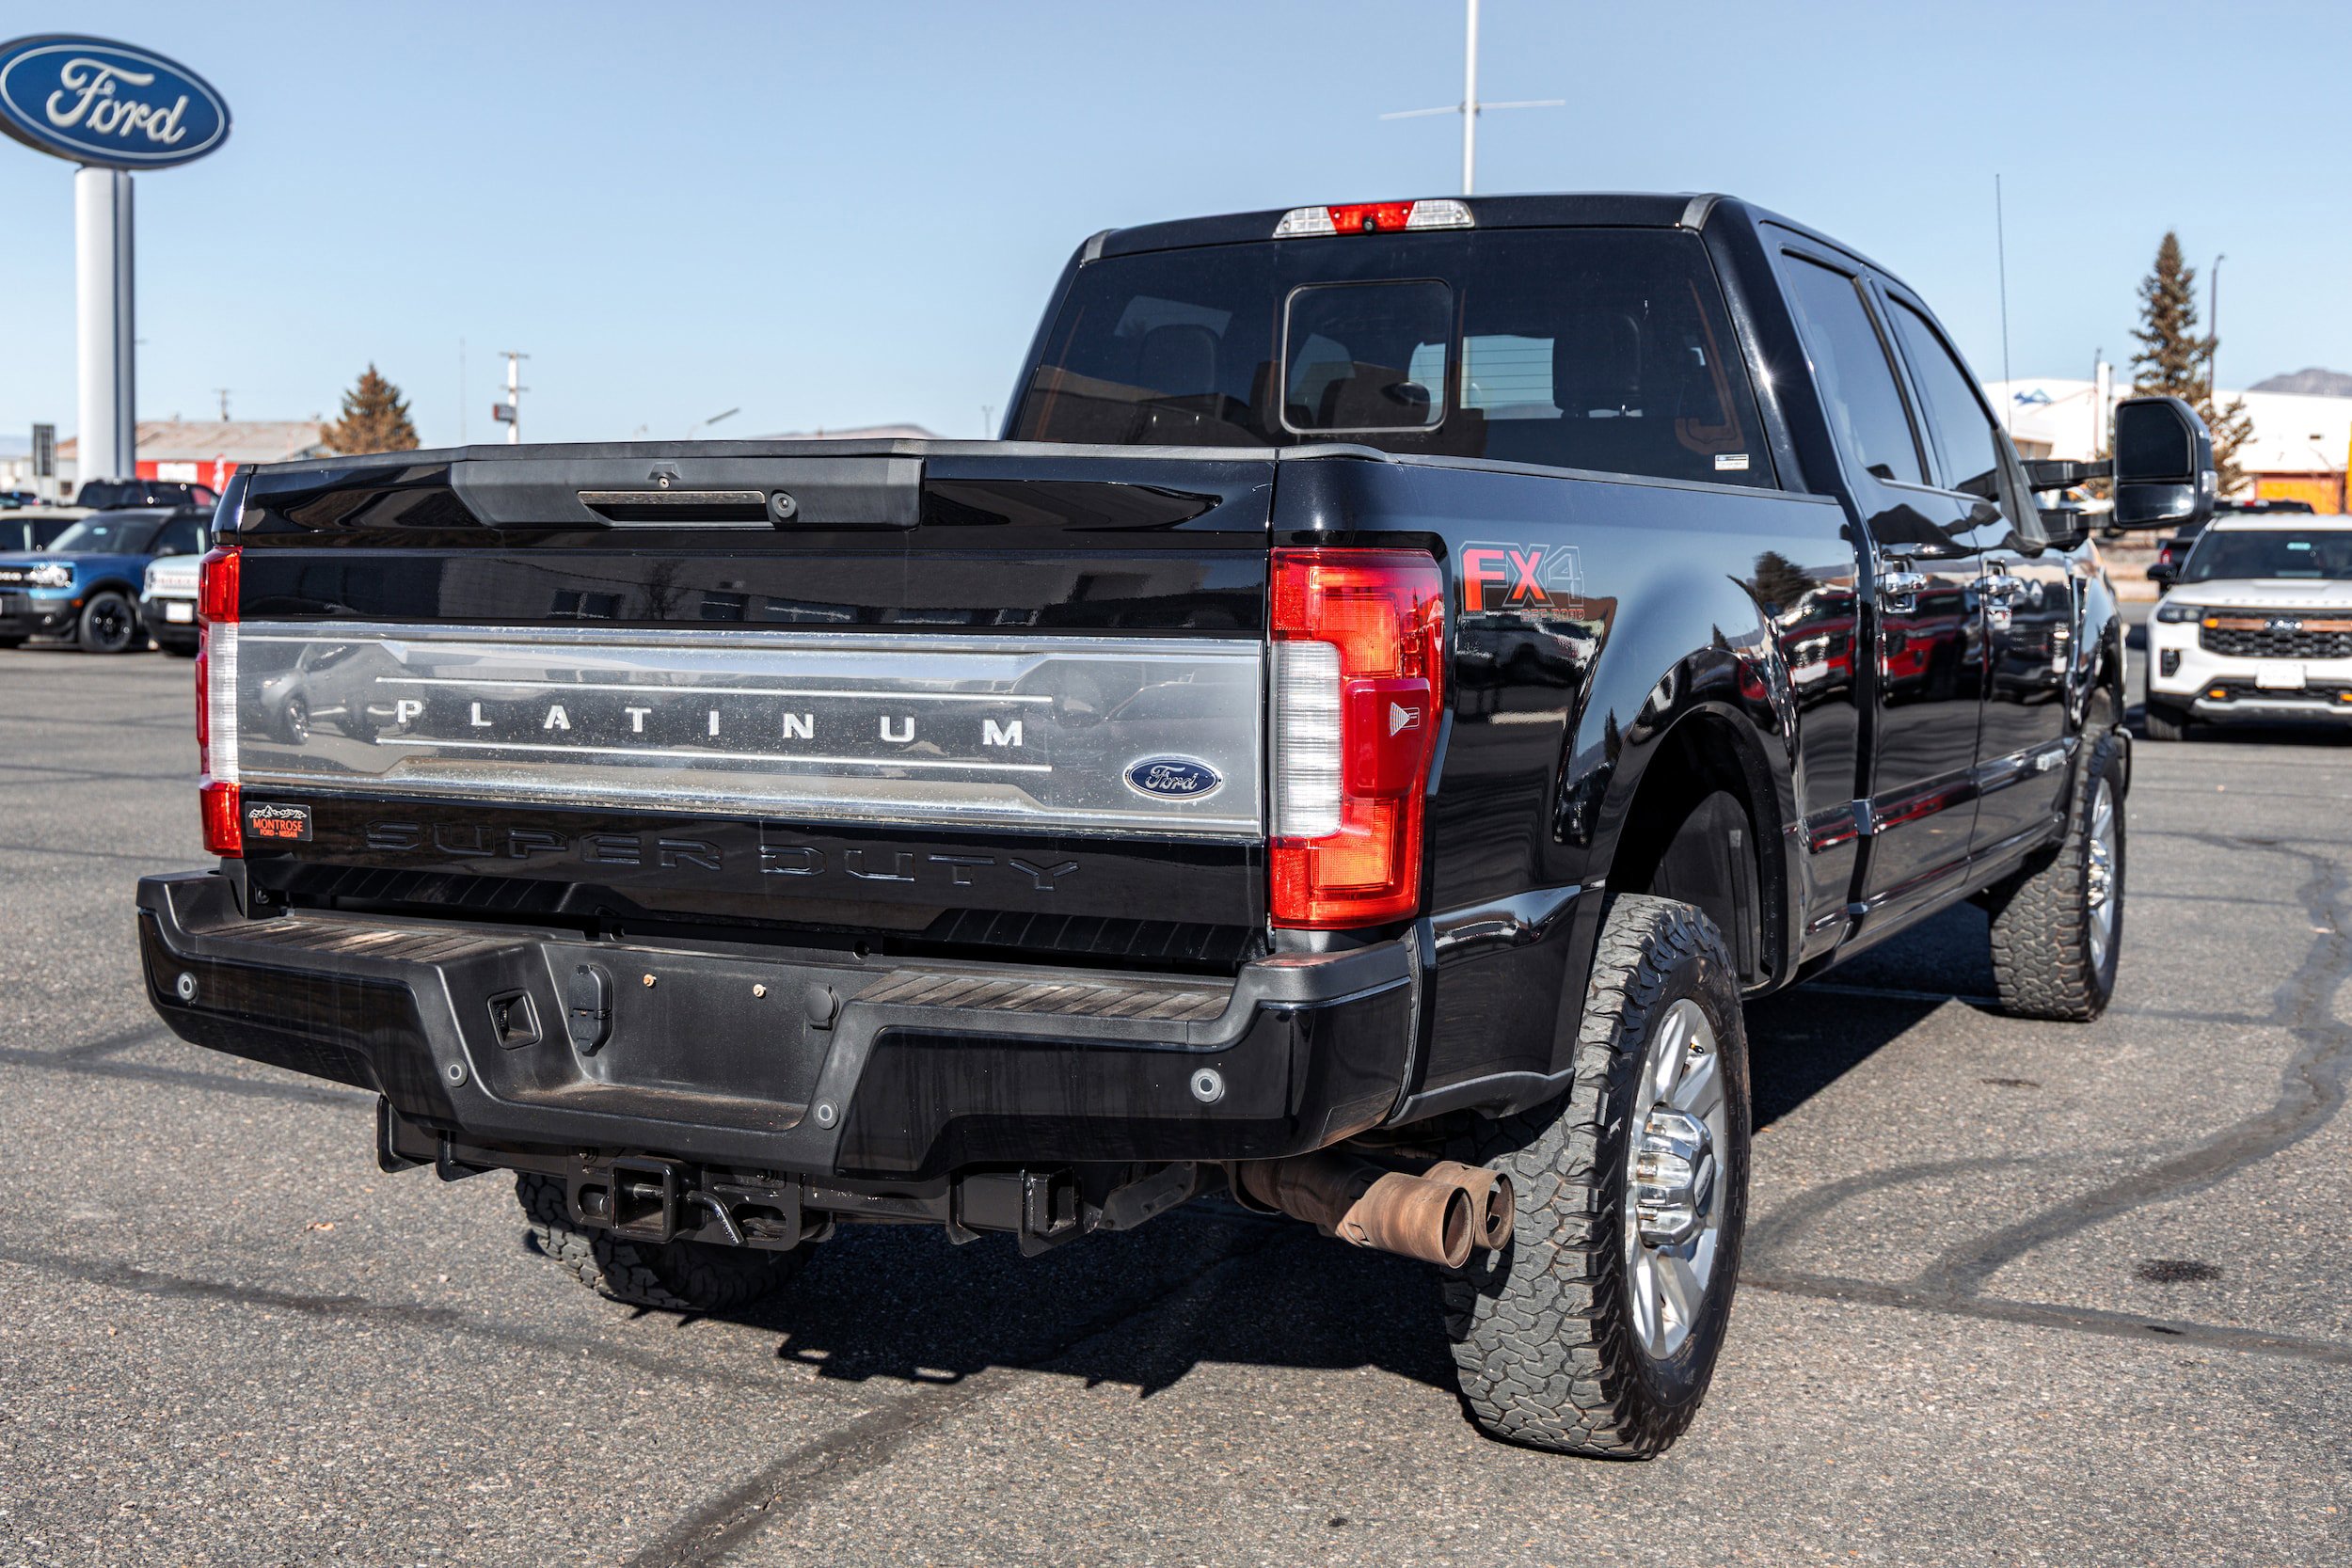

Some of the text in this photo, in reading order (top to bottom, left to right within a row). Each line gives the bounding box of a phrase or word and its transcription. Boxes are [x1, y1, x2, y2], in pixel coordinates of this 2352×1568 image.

[46, 57, 189, 144] Ford
[1458, 540, 1584, 620] FX4
[1550, 608, 1585, 622] ROAD
[396, 698, 1023, 746] PLATINUM
[1145, 765, 1199, 790] Ford
[252, 817, 303, 832] MONTROSE
[259, 828, 275, 836] FORD
[278, 830, 298, 838] NISSAN
[365, 820, 1081, 893] SUPER DUTY
